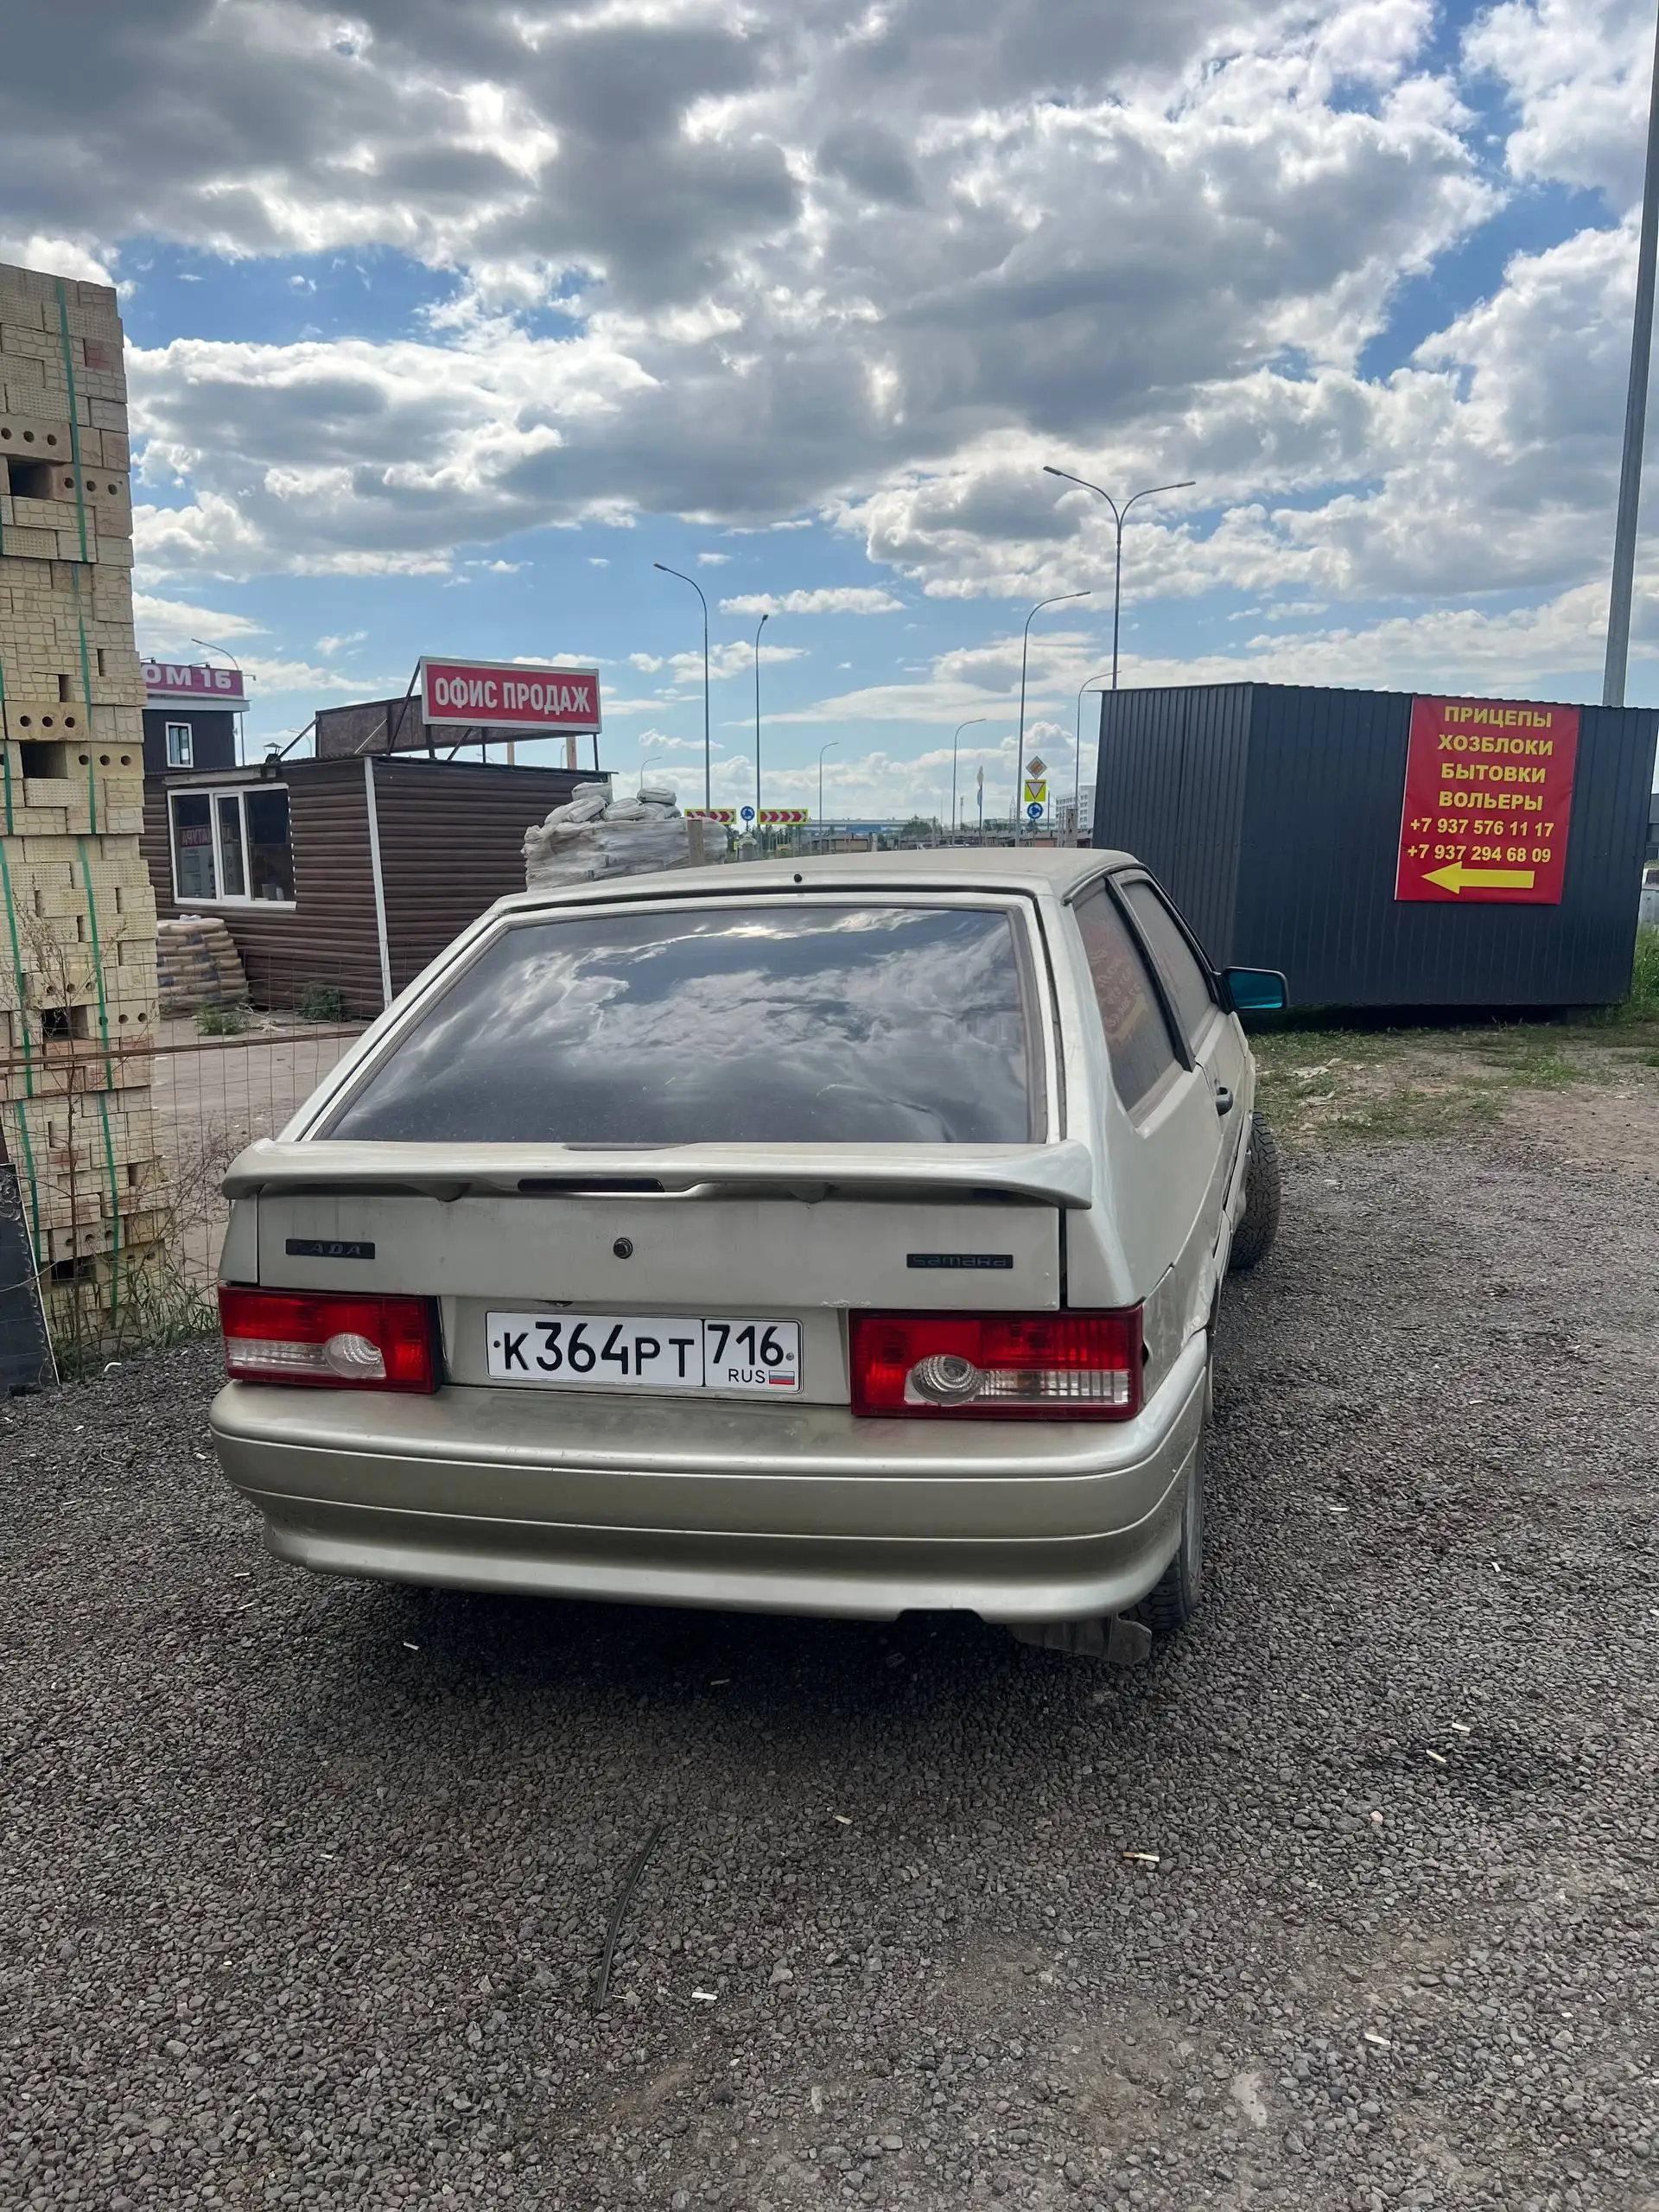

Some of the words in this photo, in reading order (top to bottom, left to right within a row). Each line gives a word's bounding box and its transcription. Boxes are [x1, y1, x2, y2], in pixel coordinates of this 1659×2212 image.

[200, 669, 232, 690] 16
[435, 677, 498, 709] ОФИС
[503, 682, 591, 715] ПРОДАЖ
[1445, 706, 1552, 728] ПРИЦЕПЫ
[1438, 734, 1554, 756] ХОЗБЛОКИ
[1441, 763, 1546, 784] БЫТОВКИ
[1439, 791, 1543, 810] ВОЛЬЕРЫ
[1410, 817, 1433, 833] +7
[1437, 819, 1469, 835] 937
[1473, 820, 1504, 836] 576
[1510, 822, 1529, 836] 11
[1535, 823, 1554, 837] 17
[1408, 843, 1430, 859] +7
[1434, 844, 1466, 861] 937
[1471, 846, 1502, 861] 294
[1506, 848, 1527, 862] 68
[1531, 849, 1552, 863] 09
[504, 1322, 695, 1377] К364РТ
[707, 1324, 784, 1366] 716
[728, 1369, 766, 1383] RUS
